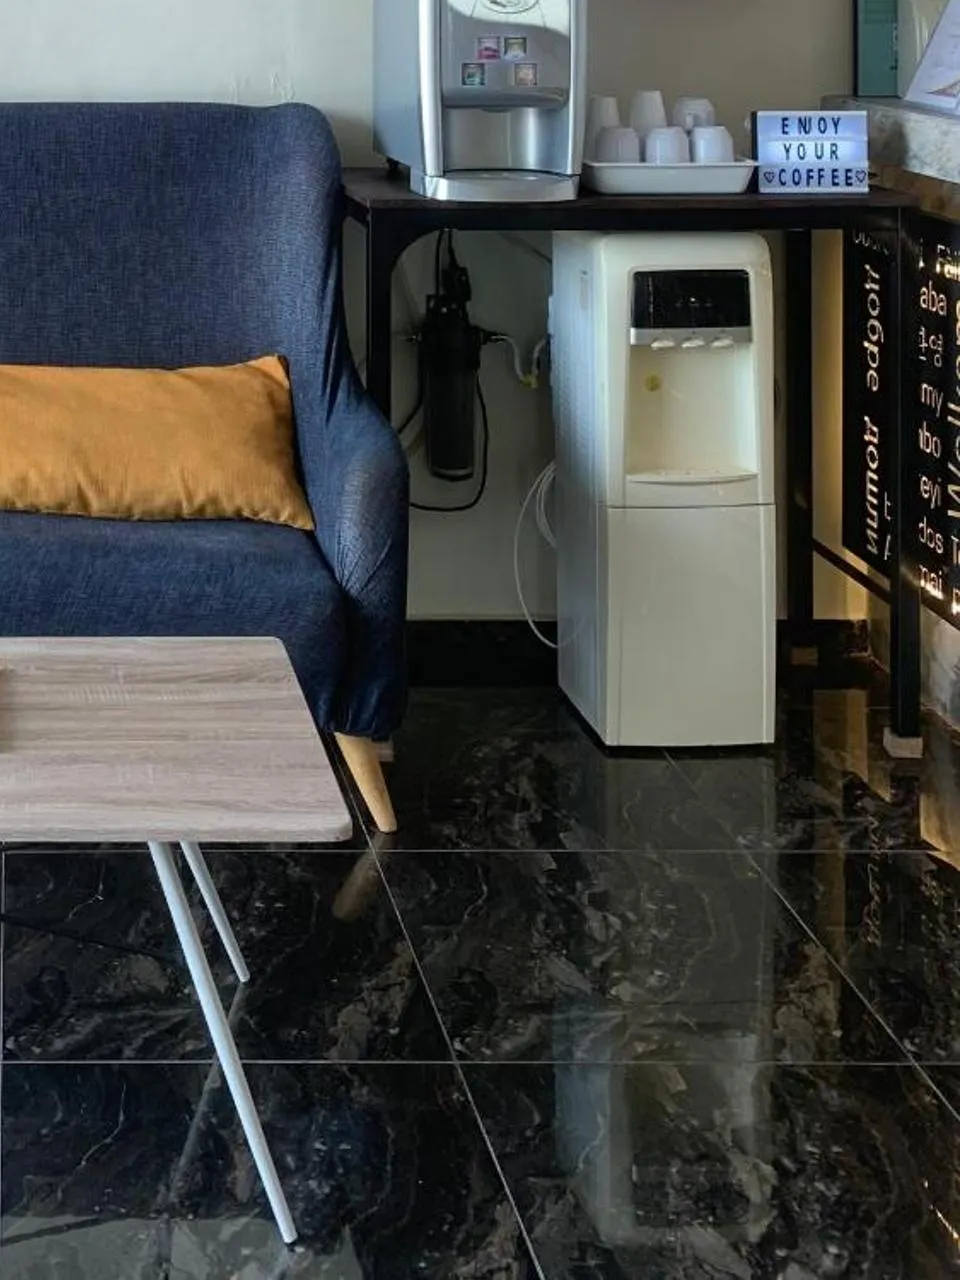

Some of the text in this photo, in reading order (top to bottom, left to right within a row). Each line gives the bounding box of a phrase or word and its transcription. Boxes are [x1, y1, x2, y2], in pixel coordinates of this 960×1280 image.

[781, 117, 841, 135] ENJOY
[783, 143, 838, 160] YOUR
[778, 168, 853, 187] COFFEE
